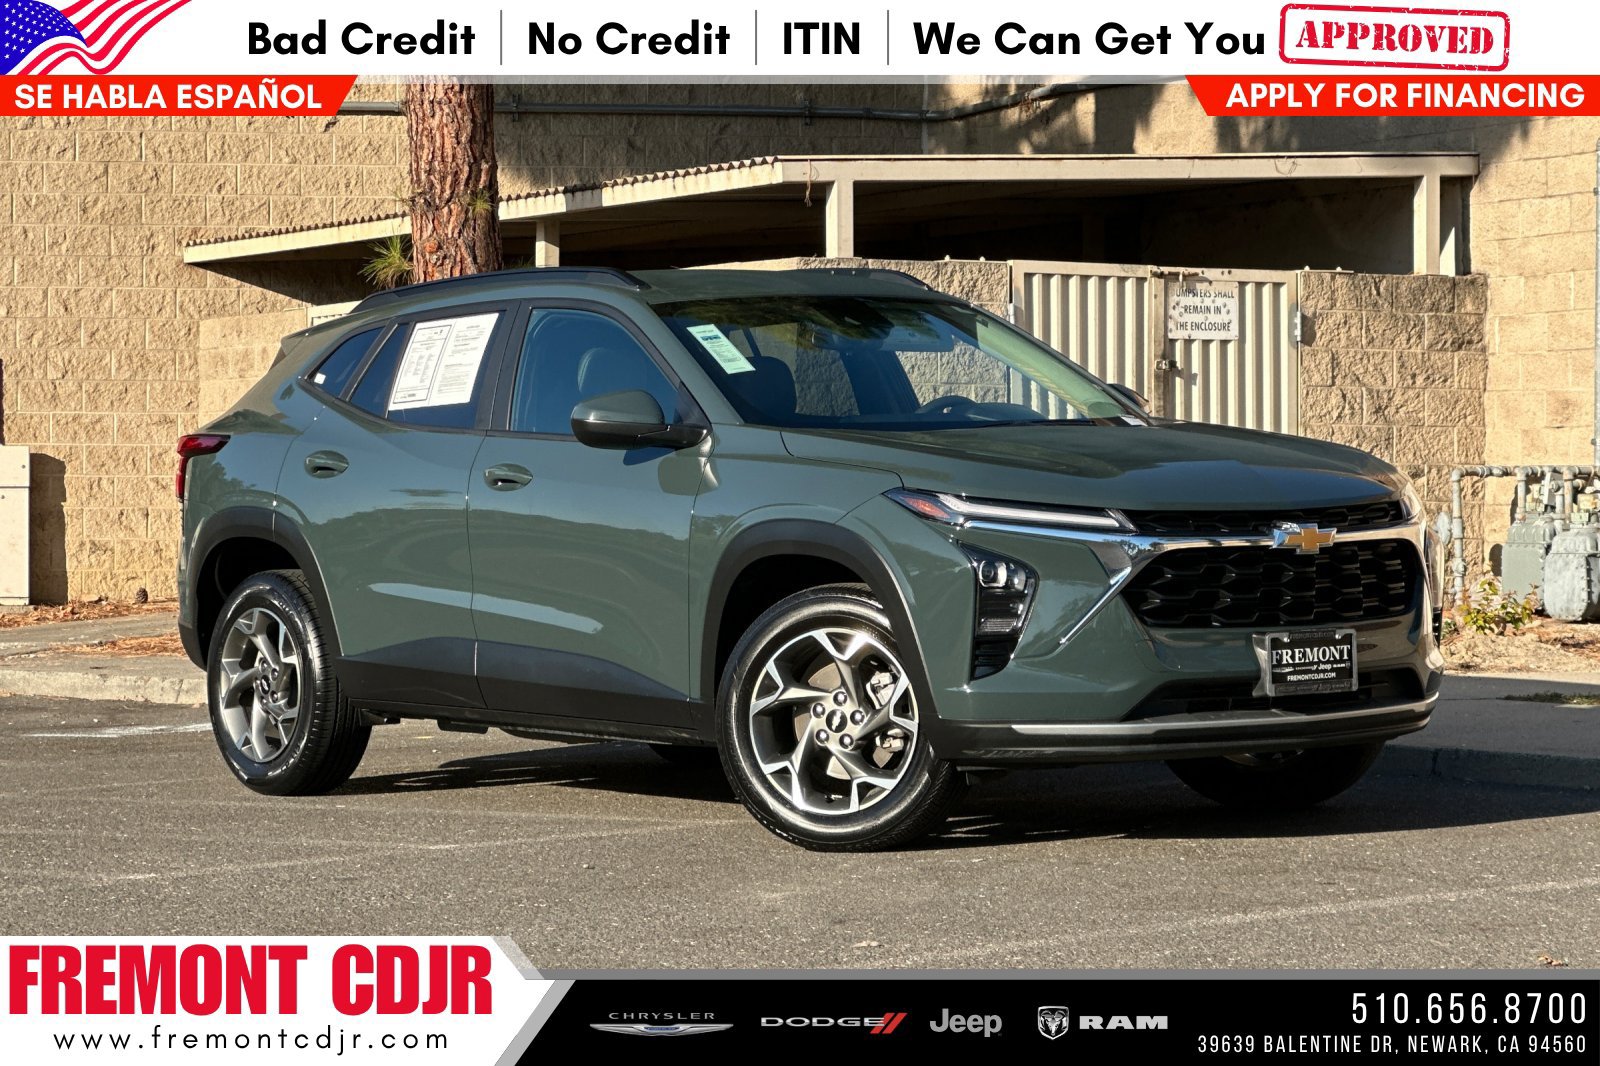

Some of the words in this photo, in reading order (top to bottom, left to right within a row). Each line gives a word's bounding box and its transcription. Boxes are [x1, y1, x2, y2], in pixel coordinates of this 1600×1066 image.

[1171, 288, 1212, 298] UMPSTERS
[1213, 290, 1234, 298] SHALL
[1183, 304, 1211, 315] REMAIN
[1213, 304, 1222, 315] IN
[1190, 321, 1231, 332] ENCLOSURE
[1271, 645, 1351, 664] FREMONT
